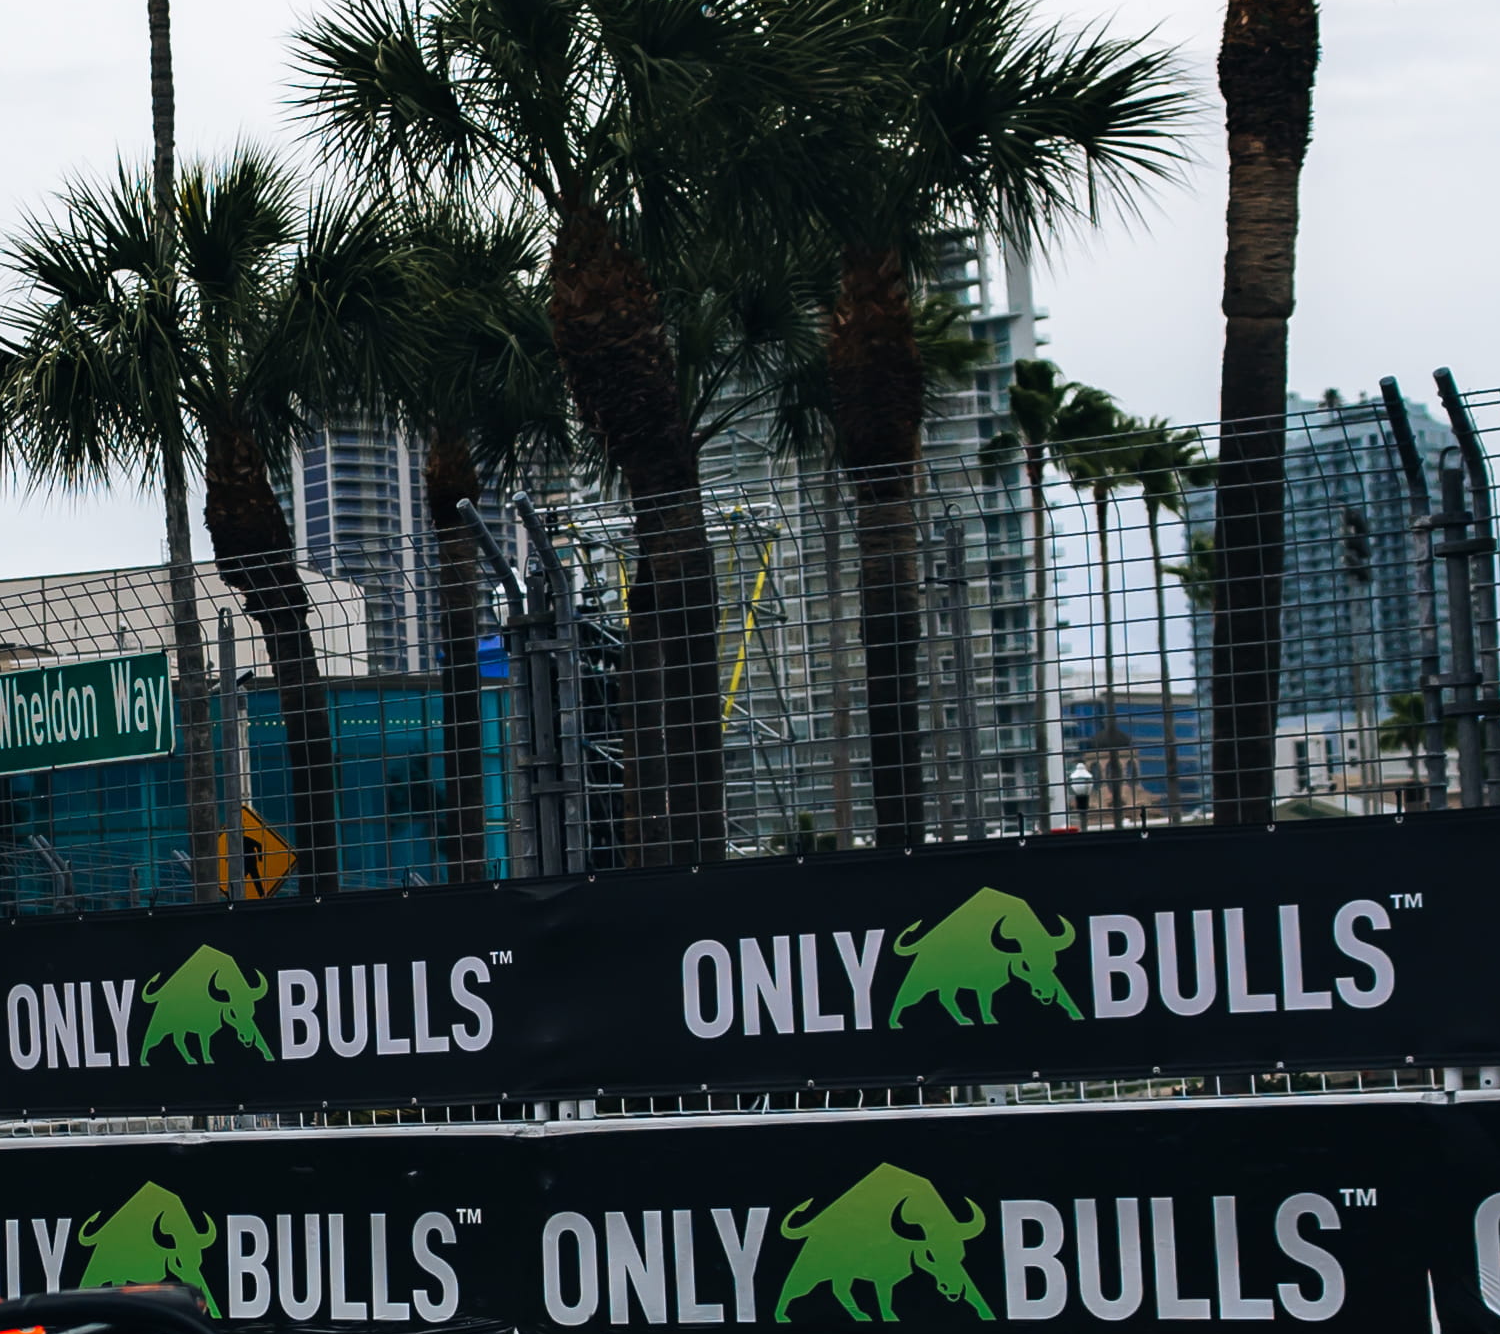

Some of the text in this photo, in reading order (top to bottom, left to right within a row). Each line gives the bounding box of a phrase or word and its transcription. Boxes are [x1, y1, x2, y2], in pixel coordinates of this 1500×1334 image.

[110, 660, 166, 750] Way
[7, 980, 137, 1070] ONLY
[682, 928, 884, 1039] ONLY
[541, 1207, 770, 1326] ONLY
